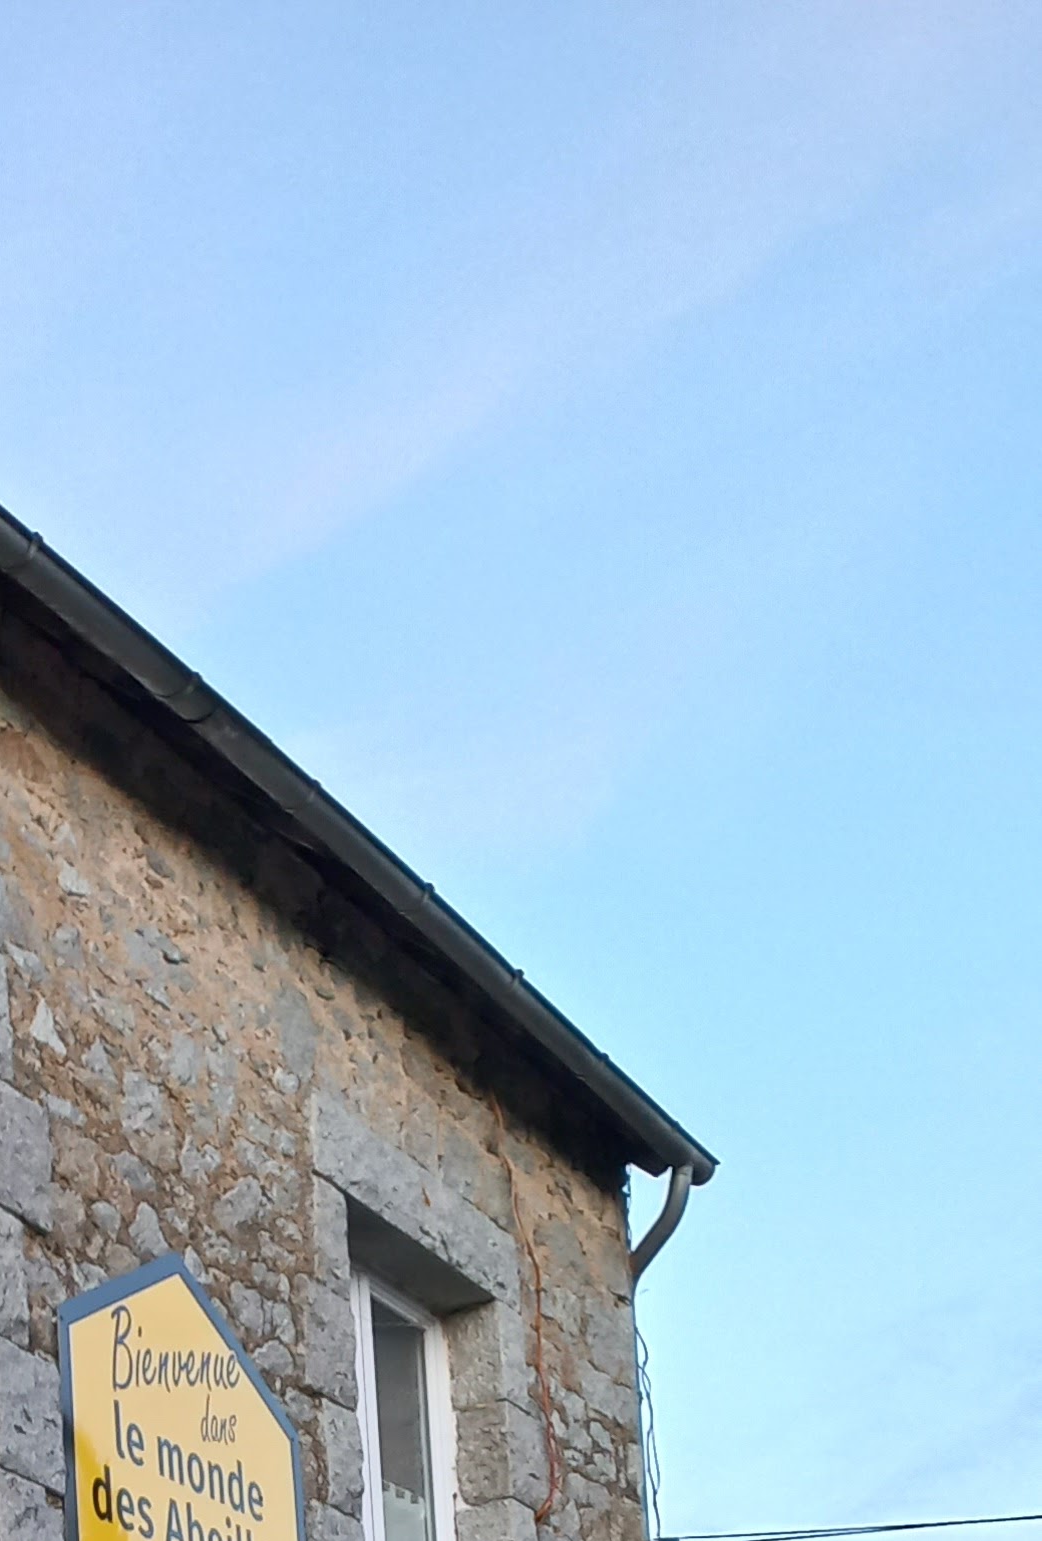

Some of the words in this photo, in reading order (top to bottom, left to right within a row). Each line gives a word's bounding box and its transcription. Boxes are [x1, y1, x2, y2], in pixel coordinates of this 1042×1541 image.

[110, 1304, 241, 1394] Bienvenue
[113, 1398, 145, 1467] le
[156, 1435, 264, 1522] monde
[200, 1392, 238, 1446] dans
[91, 1463, 155, 1539] des
